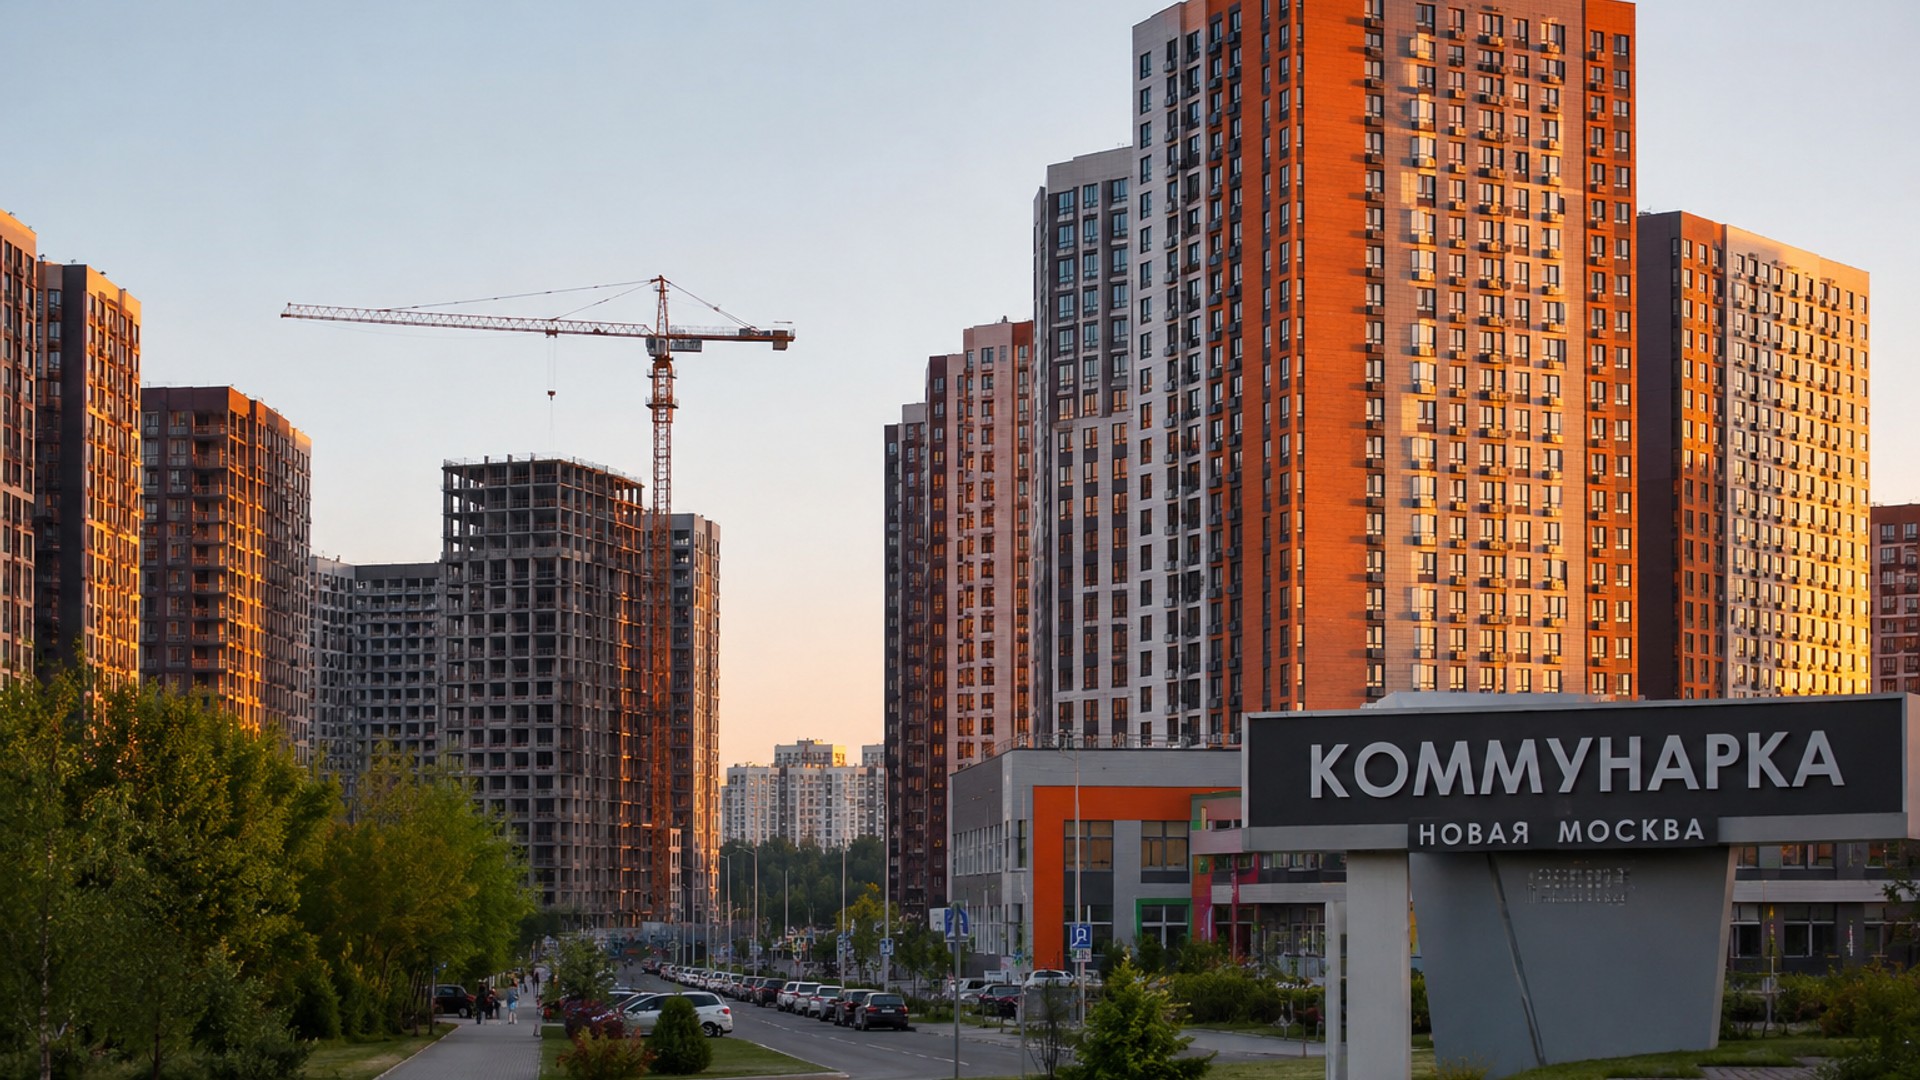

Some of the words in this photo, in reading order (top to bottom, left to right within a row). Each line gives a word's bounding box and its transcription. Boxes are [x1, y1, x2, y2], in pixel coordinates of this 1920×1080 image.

[1310, 730, 1846, 799] КОММУНАРКА
[1418, 821, 1529, 846] НОВАЯ
[1557, 818, 1705, 844] МОСКВА
